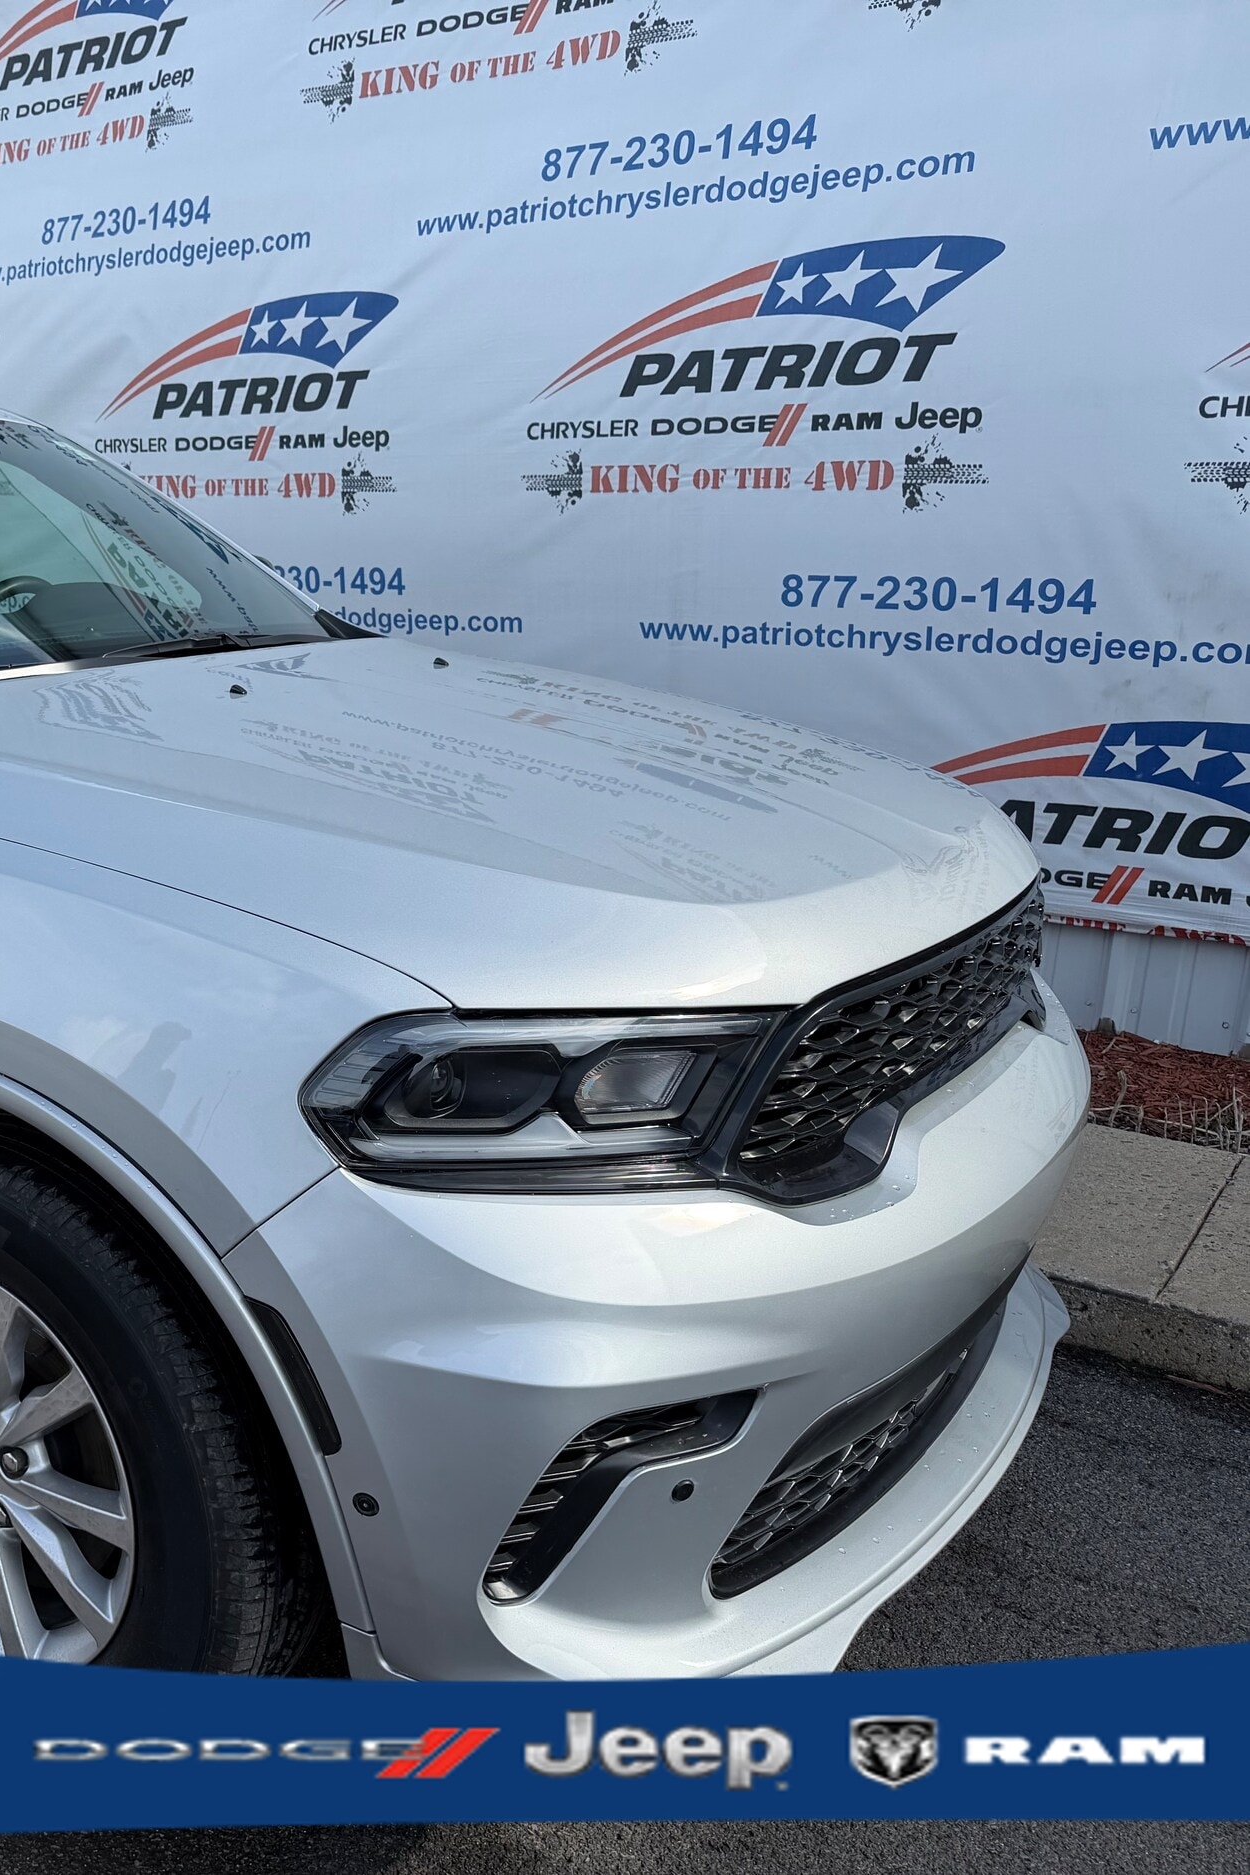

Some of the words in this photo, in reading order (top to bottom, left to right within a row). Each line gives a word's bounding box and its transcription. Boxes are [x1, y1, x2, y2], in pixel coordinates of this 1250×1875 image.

[308, 23, 407, 56] CHRYSLER
[415, 4, 526, 38] DODGE
[359, 59, 440, 100] KING
[450, 59, 481, 83] OF
[486, 51, 537, 78] THE
[546, 29, 621, 70] 4WD
[15, 92, 88, 119] DODGE
[104, 81, 144, 102] RAM
[148, 66, 194, 92] Jeep
[36, 136, 56, 157] OF
[59, 129, 92, 153] THE
[96, 114, 145, 144] 4WD
[541, 114, 818, 182] 877-230-1494
[417, 150, 976, 236] www.patriotchryslerdodgejeep.com
[41, 195, 211, 246] 877-230-1494
[619, 332, 957, 398] PATRIOT
[152, 369, 370, 420] PATRIOT
[94, 437, 167, 455] CHRYSLER
[175, 434, 258, 453] DODGE
[278, 432, 325, 451] RAM
[333, 425, 390, 451] Jeep
[526, 418, 638, 441] CHRYSLER
[650, 414, 780, 436] DODGE
[811, 410, 883, 432] RAM
[895, 401, 982, 434] Jeep
[204, 479, 228, 497] OF
[231, 478, 270, 497] THE
[277, 472, 337, 499] 4WD
[590, 463, 680, 494] KING
[693, 468, 727, 490] OF
[735, 466, 791, 490] THE
[804, 460, 895, 492] 4WD
[781, 573, 1098, 616] 877-230-1494
[639, 619, 1250, 668] www.patriotchryslerdodgejeep.co
[1148, 880, 1233, 905] RAM
